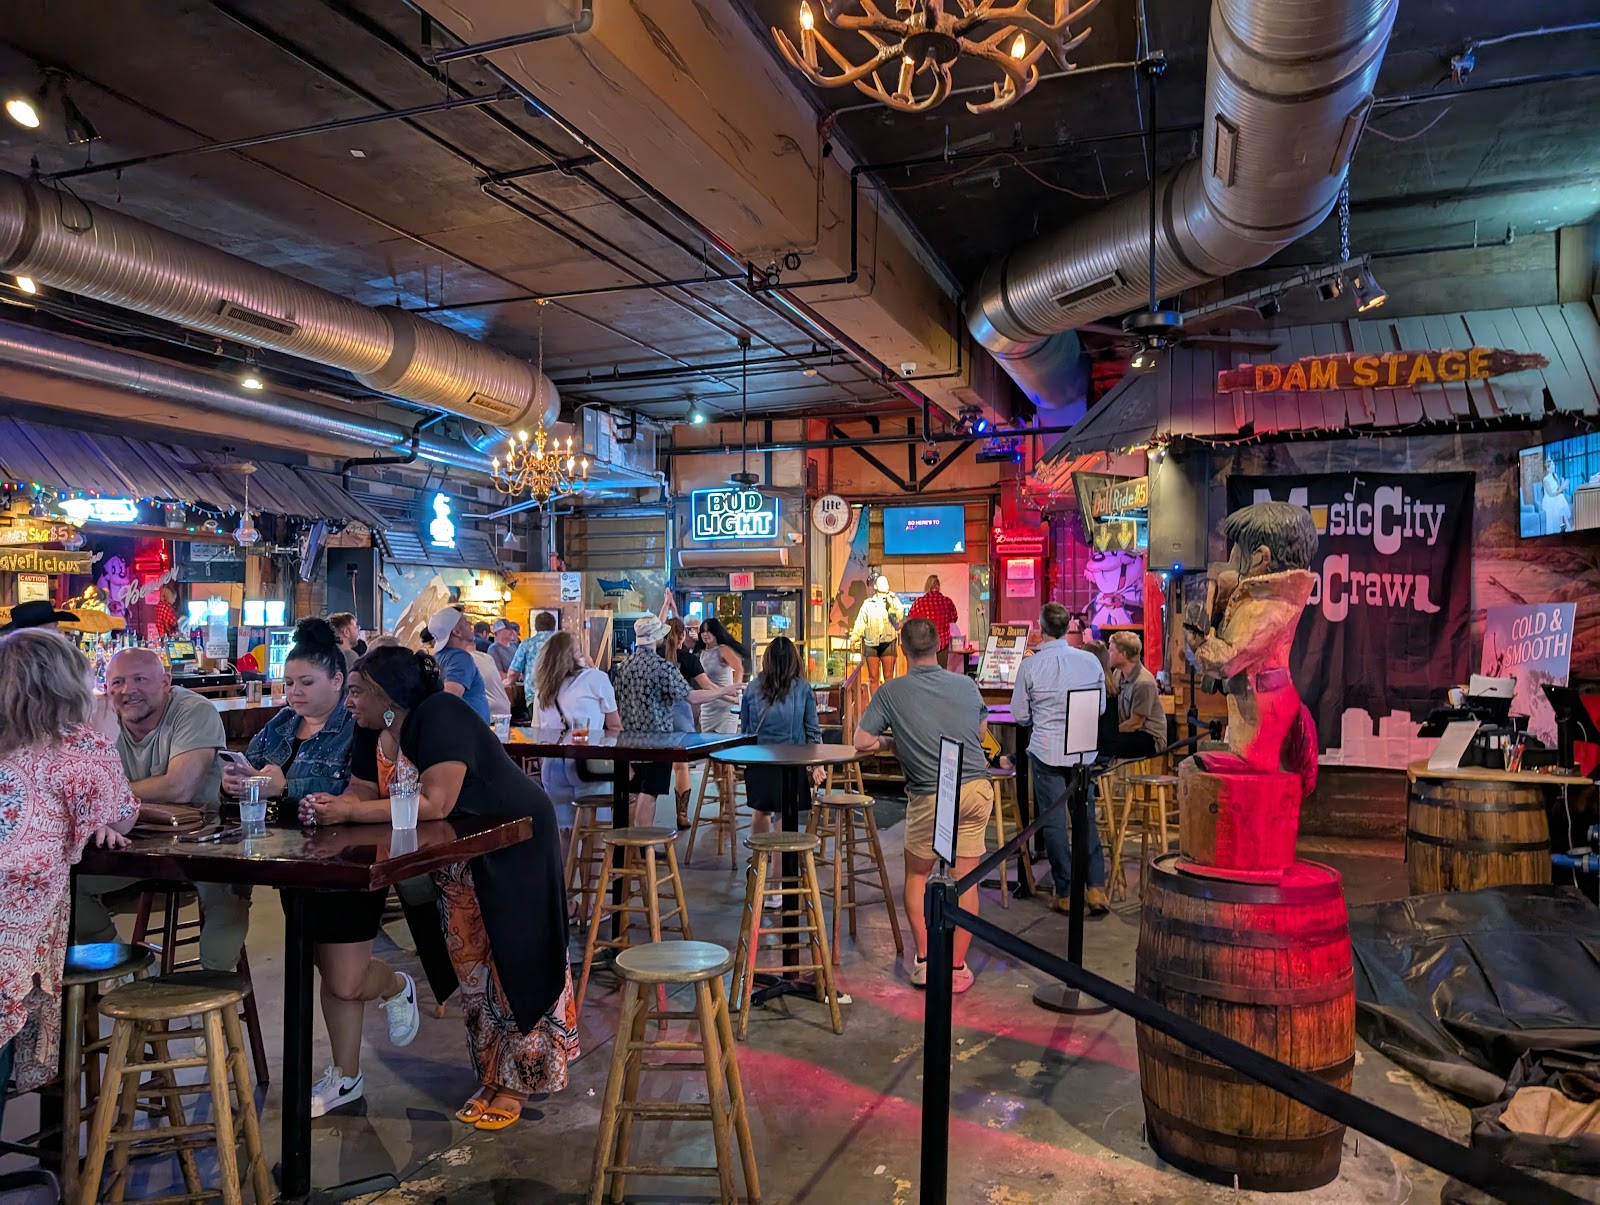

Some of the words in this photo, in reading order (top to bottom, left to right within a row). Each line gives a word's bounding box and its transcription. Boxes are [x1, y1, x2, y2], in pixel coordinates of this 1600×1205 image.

[1255, 360, 1337, 391] DAM
[1353, 346, 1489, 387] STAGE
[707, 491, 763, 514] BUD
[822, 500, 841, 513] Lite
[1112, 487, 1134, 511] Ride
[1134, 483, 1146, 504] $5
[49, 525, 69, 542] $5
[697, 512, 773, 535] LIGHT
[118, 566, 179, 609] Beaver
[733, 574, 750, 588] EXIT
[251, 628, 264, 638] Bull
[1511, 612, 1547, 641] COLD
[1549, 608, 1563, 632] &
[1505, 632, 1568, 668] SMOOTH
